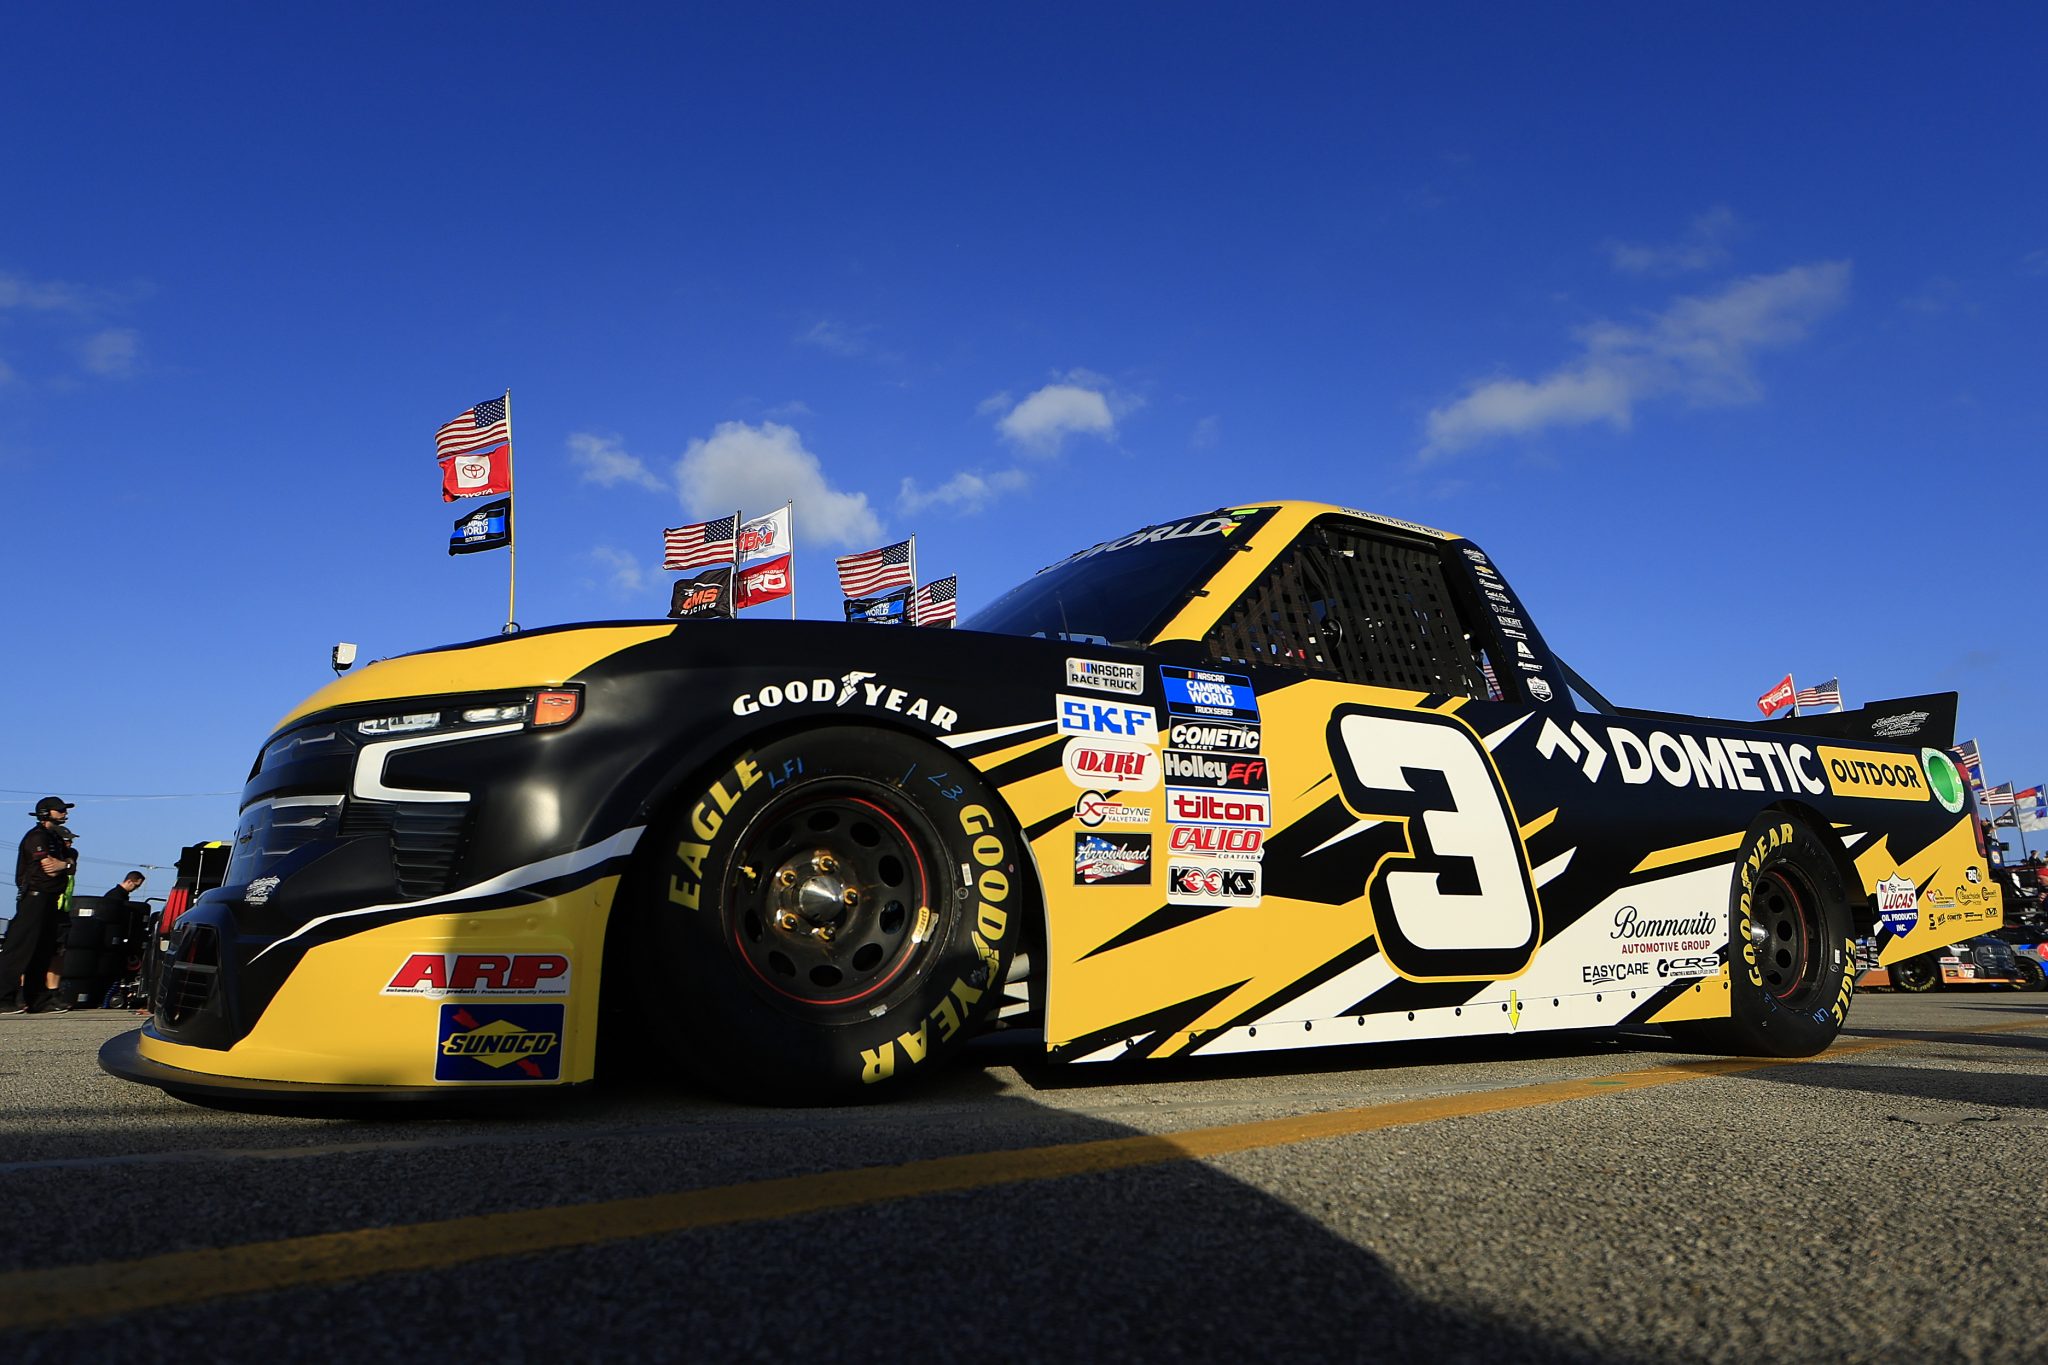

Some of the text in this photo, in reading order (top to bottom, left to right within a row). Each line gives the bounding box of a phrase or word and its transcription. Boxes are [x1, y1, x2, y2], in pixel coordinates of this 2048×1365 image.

[463, 526, 488, 536] WORLD
[865, 607, 889, 617] WORLD
[1091, 664, 1133, 678] NASCAR
[1197, 672, 1225, 683] NASCAR
[1072, 674, 1137, 690] RACE TRUCK
[1186, 681, 1233, 695] CAMPING
[1188, 691, 1235, 707] WORLD
[1062, 701, 1152, 736] SKF
[1195, 706, 1233, 717] TRUCK SERIES
[1171, 725, 1259, 749] COMETIC
[1164, 753, 1227, 786] Holley
[1607, 727, 1825, 795] DOMETIC
[1831, 759, 1922, 789] OUTDOOR
[1174, 795, 1264, 822] tilton
[1108, 815, 1149, 823] VALVETRAIN
[668, 755, 764, 912] EAGLE
[1170, 827, 1262, 852] CALICO
[1334, 709, 1537, 962] 3
[1075, 842, 1150, 861] Arrowhead
[1092, 860, 1125, 874] Brass
[1169, 867, 1255, 896] KOOKS
[1883, 893, 1914, 909] LUCAS
[1610, 905, 1717, 939] Bommarito
[1882, 912, 1918, 922] OIL PRODUCTS
[1621, 940, 1711, 954] AUTOMOTIVE GROUP
[387, 954, 569, 989] ARP
[1669, 956, 1719, 969] CRS
[1831, 938, 1857, 1027] EAGLE
[446, 1034, 553, 1053] SUNOCO
